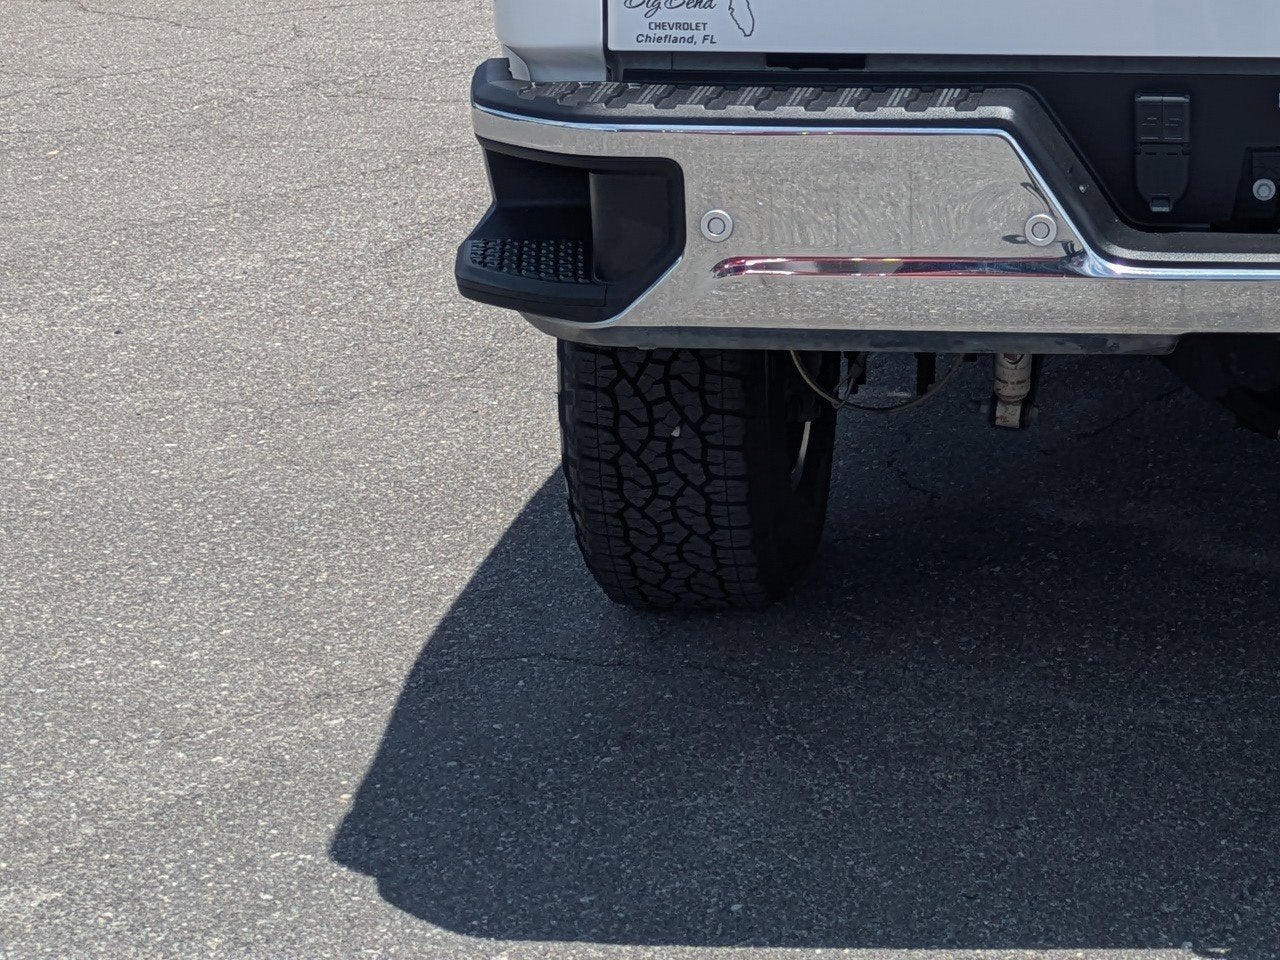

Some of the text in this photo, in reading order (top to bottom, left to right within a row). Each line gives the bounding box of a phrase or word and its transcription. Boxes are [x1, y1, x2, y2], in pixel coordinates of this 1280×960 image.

[648, 21, 708, 31] CHEVROLET
[636, 33, 717, 45] Chiefland, FL
